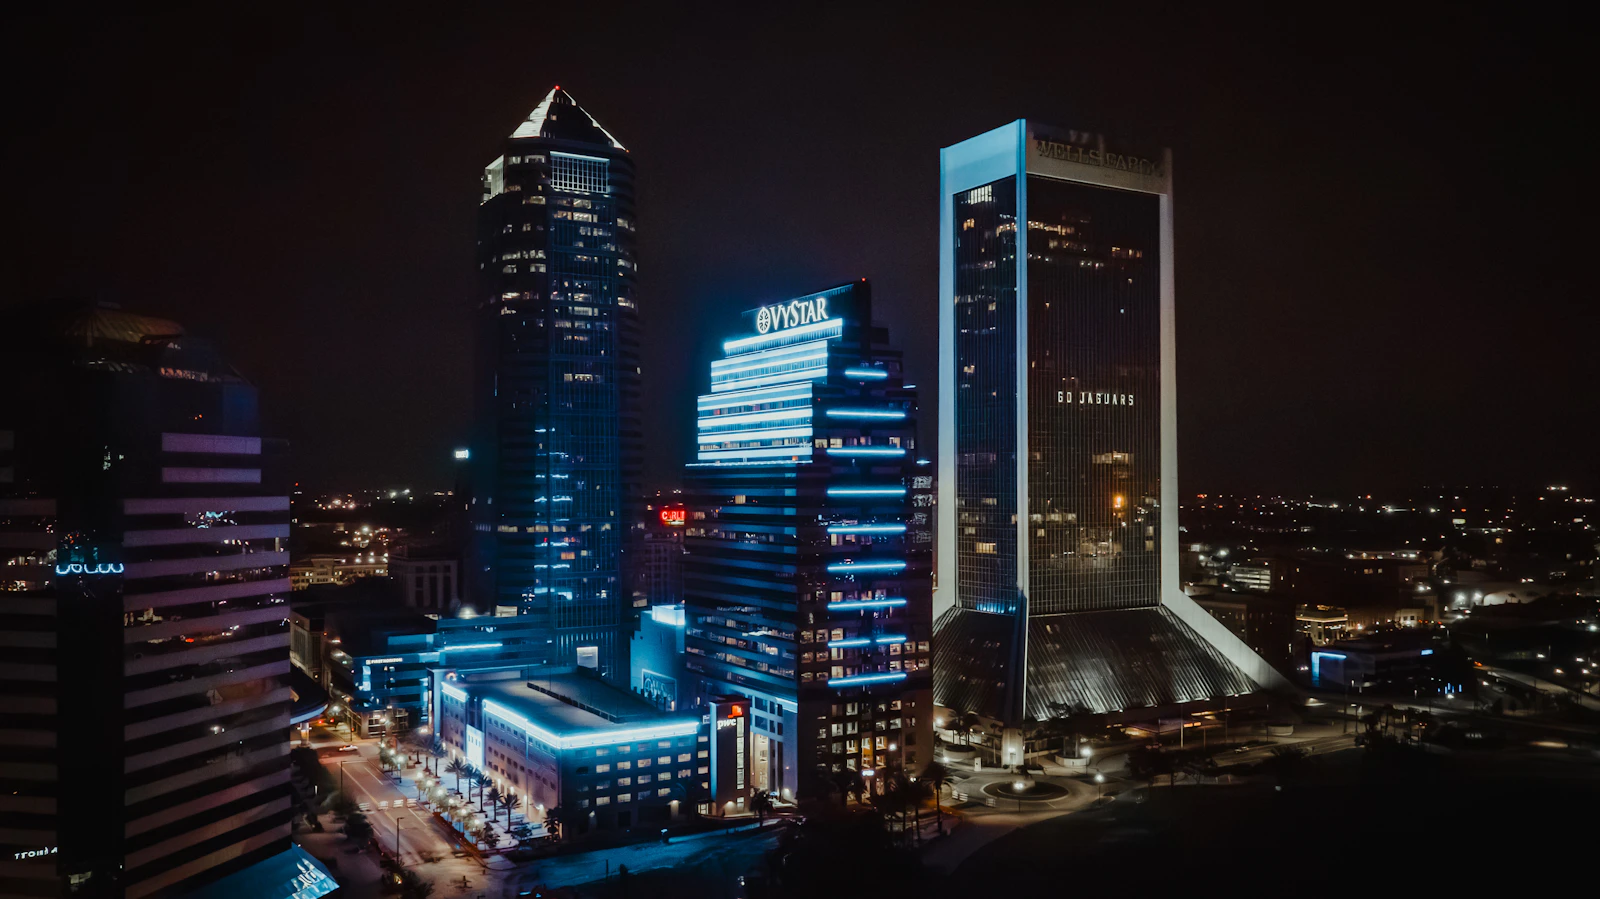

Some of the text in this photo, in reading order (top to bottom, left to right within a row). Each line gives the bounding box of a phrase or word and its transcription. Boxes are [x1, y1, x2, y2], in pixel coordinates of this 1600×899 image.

[1036, 140, 1101, 166] WELLS
[769, 297, 829, 331] VYSTAR
[1057, 391, 1134, 406] GO JAGUARS
[717, 718, 737, 730] pwc
